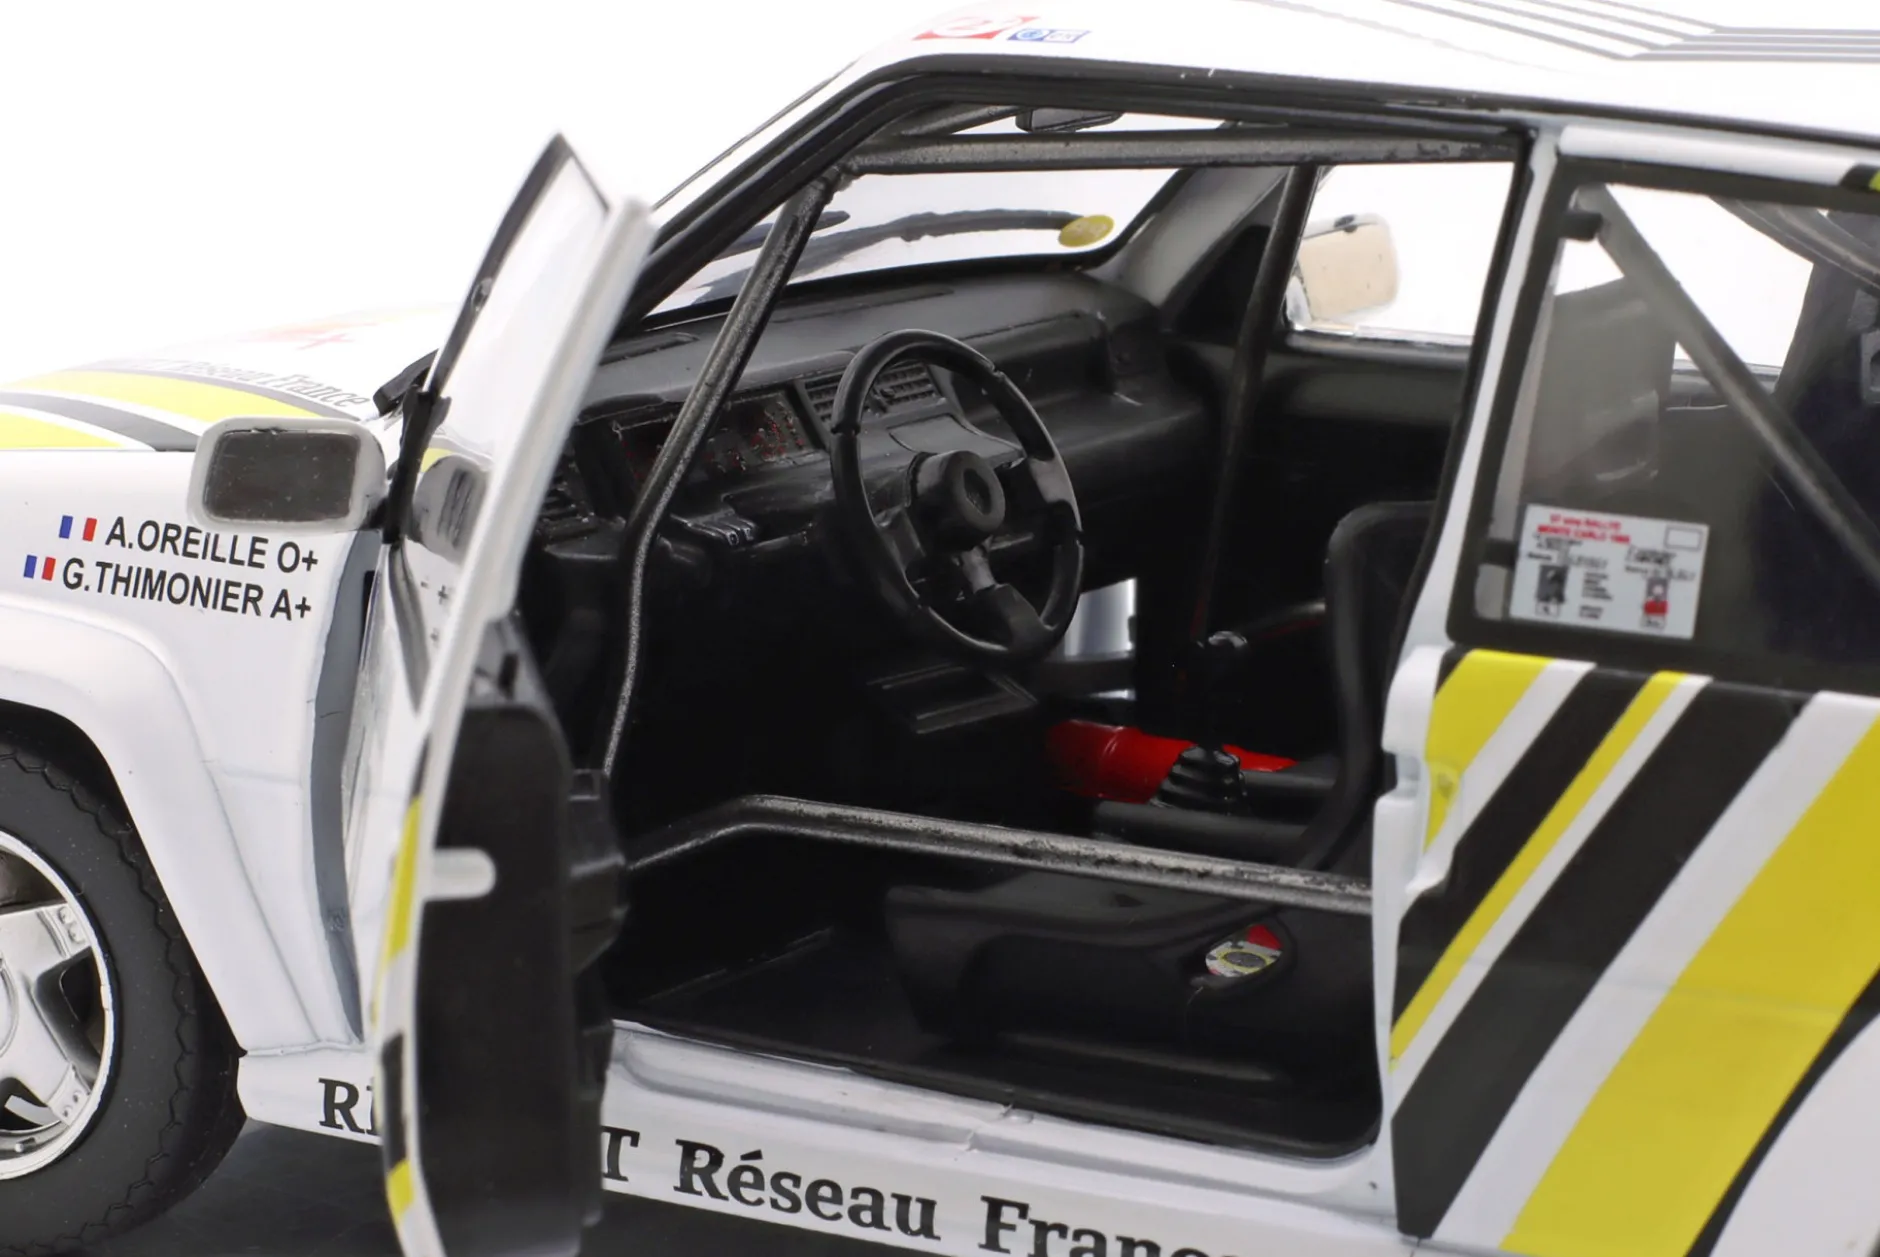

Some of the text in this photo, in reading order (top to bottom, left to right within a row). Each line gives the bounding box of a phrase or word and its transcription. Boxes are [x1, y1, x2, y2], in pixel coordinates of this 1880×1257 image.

[105, 516, 319, 573] A.OREILLE O+
[62, 557, 311, 621] G.THIMONIER A+
[672, 1138, 942, 1241] Réseau
